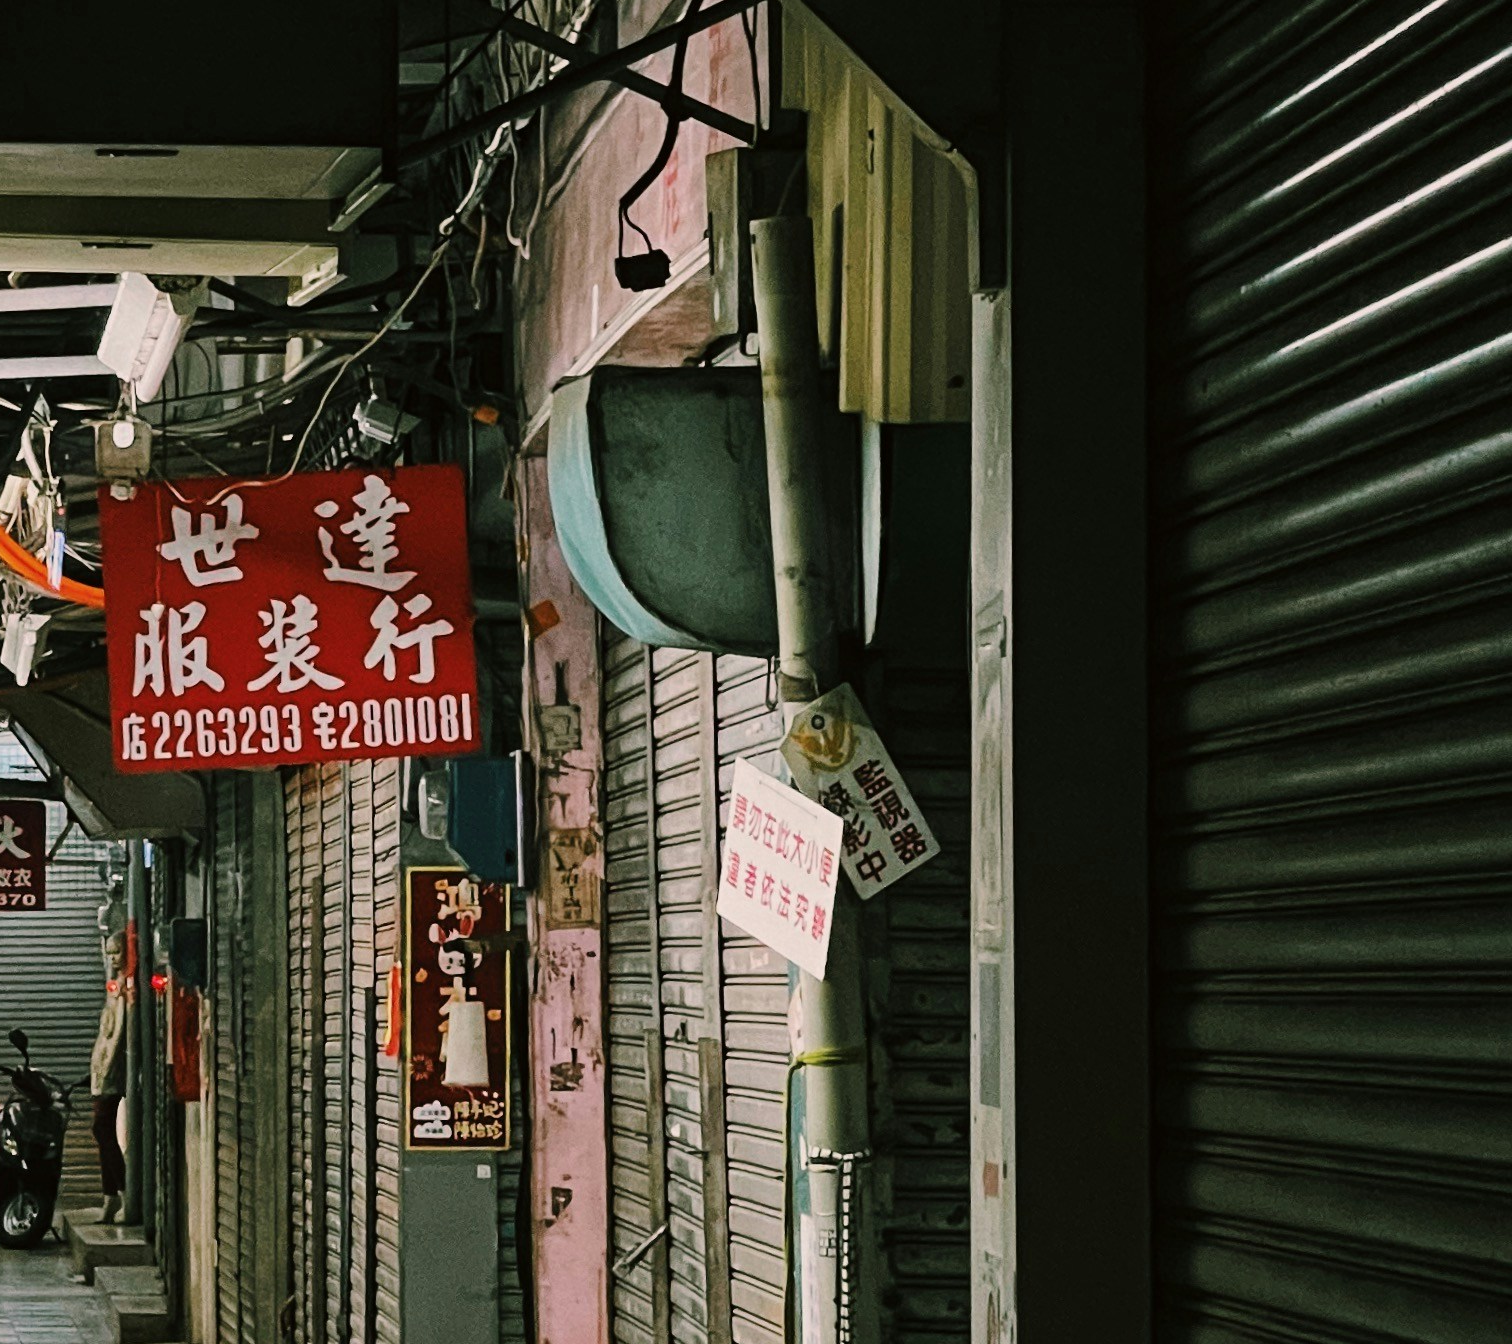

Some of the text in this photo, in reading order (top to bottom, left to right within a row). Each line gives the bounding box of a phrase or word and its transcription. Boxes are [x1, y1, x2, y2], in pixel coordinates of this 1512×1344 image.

[157, 474, 418, 593] 世達
[121, 701, 303, 762] 店2263293
[852, 759, 927, 866] 監視器
